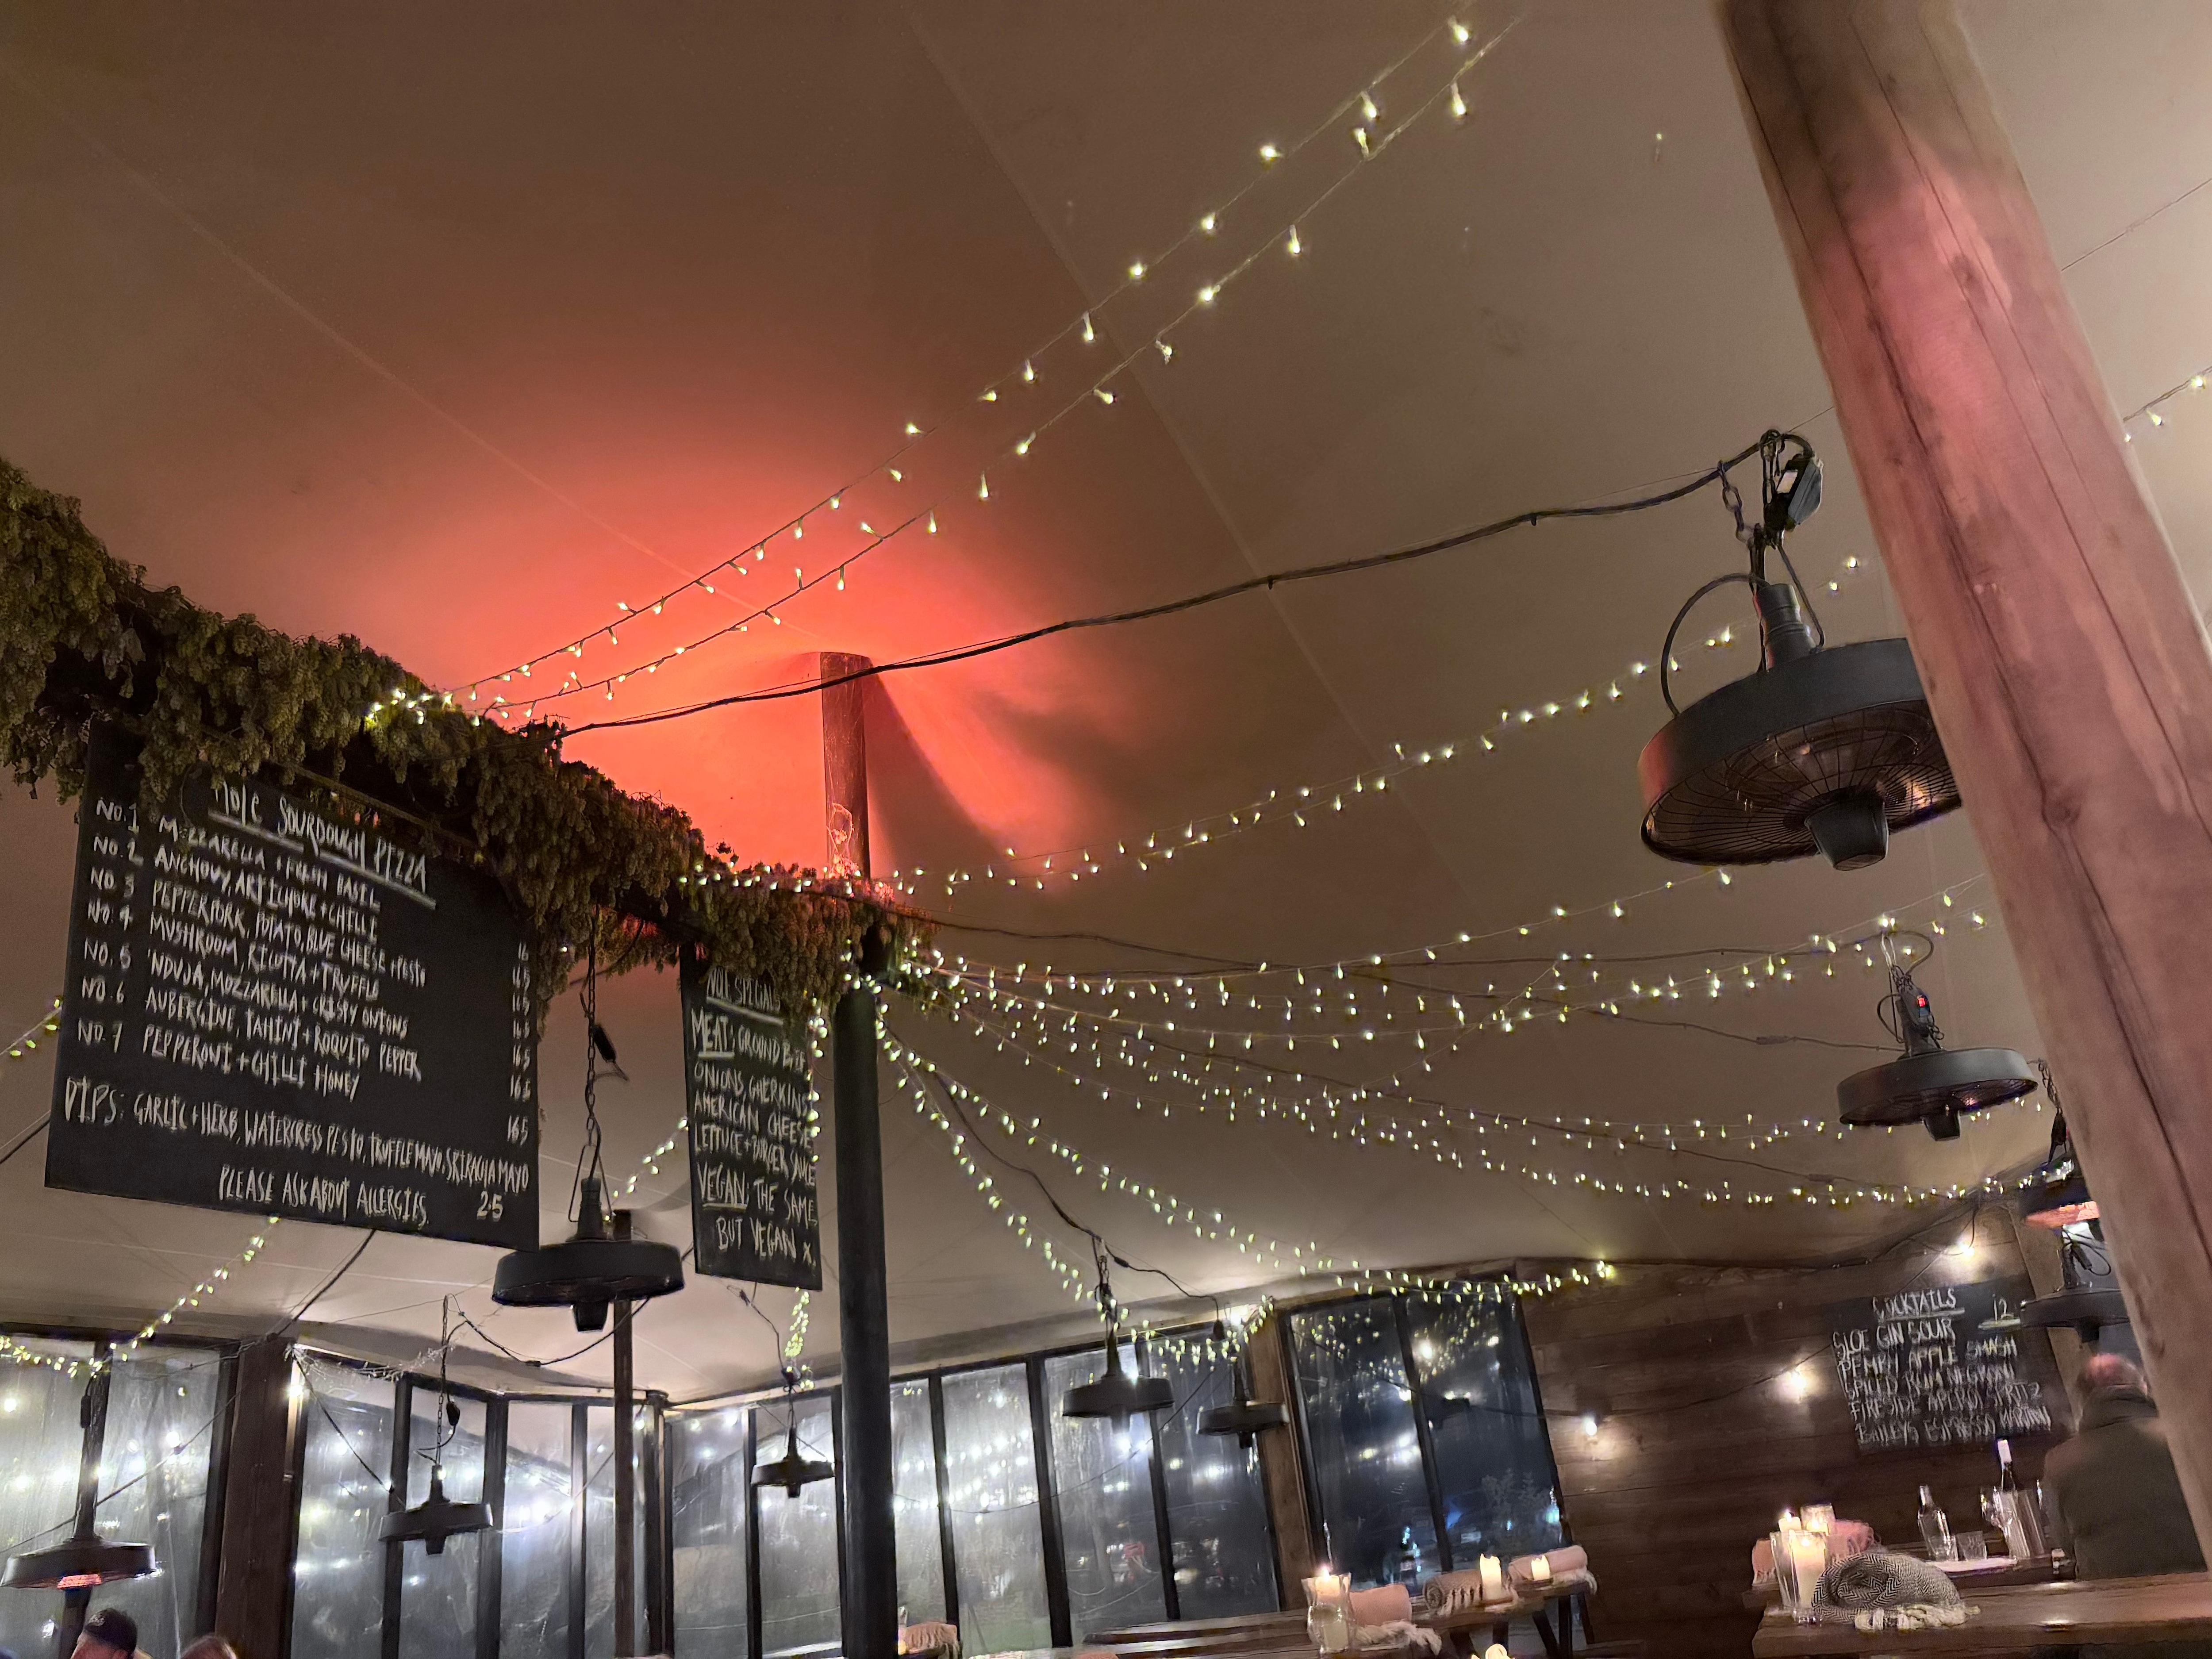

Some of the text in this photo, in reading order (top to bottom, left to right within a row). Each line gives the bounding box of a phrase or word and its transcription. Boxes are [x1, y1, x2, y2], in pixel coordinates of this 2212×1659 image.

[159, 815, 265, 871] MZZARELLA
[277, 796, 366, 871] SOURDOUGH
[374, 836, 426, 894] PIZZA
[142, 1023, 233, 1075] PEPPERONI
[313, 1062, 360, 1102] HONEY
[134, 1093, 188, 1132] GARLIC
[219, 1164, 275, 1204] PLEASE
[753, 1175, 779, 1213] THE
[716, 1214, 743, 1252] BUT
[749, 1217, 797, 1261] VEGAN
[1873, 1288, 1957, 1321] COCKTAILS
[1876, 1322, 1904, 1348] GIN
[1908, 1318, 1956, 1348] SOUR
